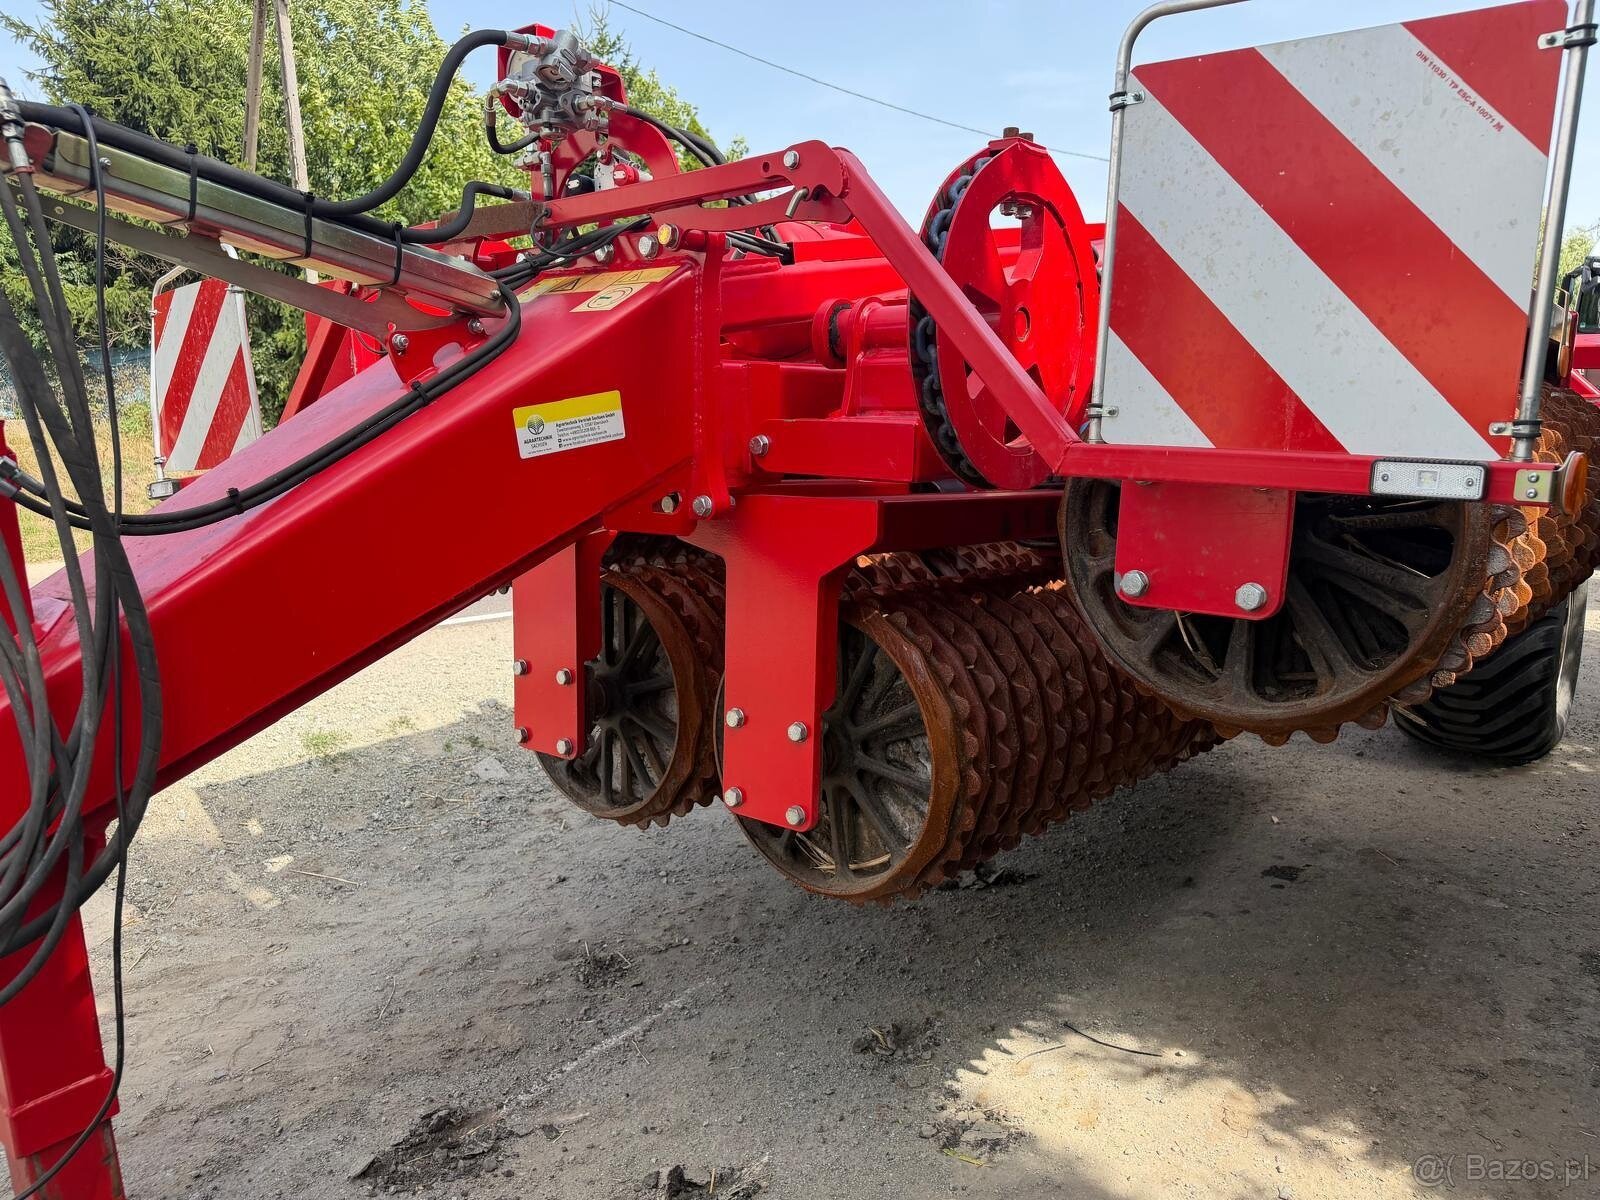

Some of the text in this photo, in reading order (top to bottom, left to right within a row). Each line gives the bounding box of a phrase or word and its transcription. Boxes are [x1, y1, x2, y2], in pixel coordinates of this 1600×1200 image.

[1416, 50, 1429, 62] DIN
[1428, 61, 1447, 79] 11030
[1449, 80, 1459, 89] TP
[1476, 105, 1496, 123] 10071
[524, 434, 553, 444] AGRARTECHNIK
